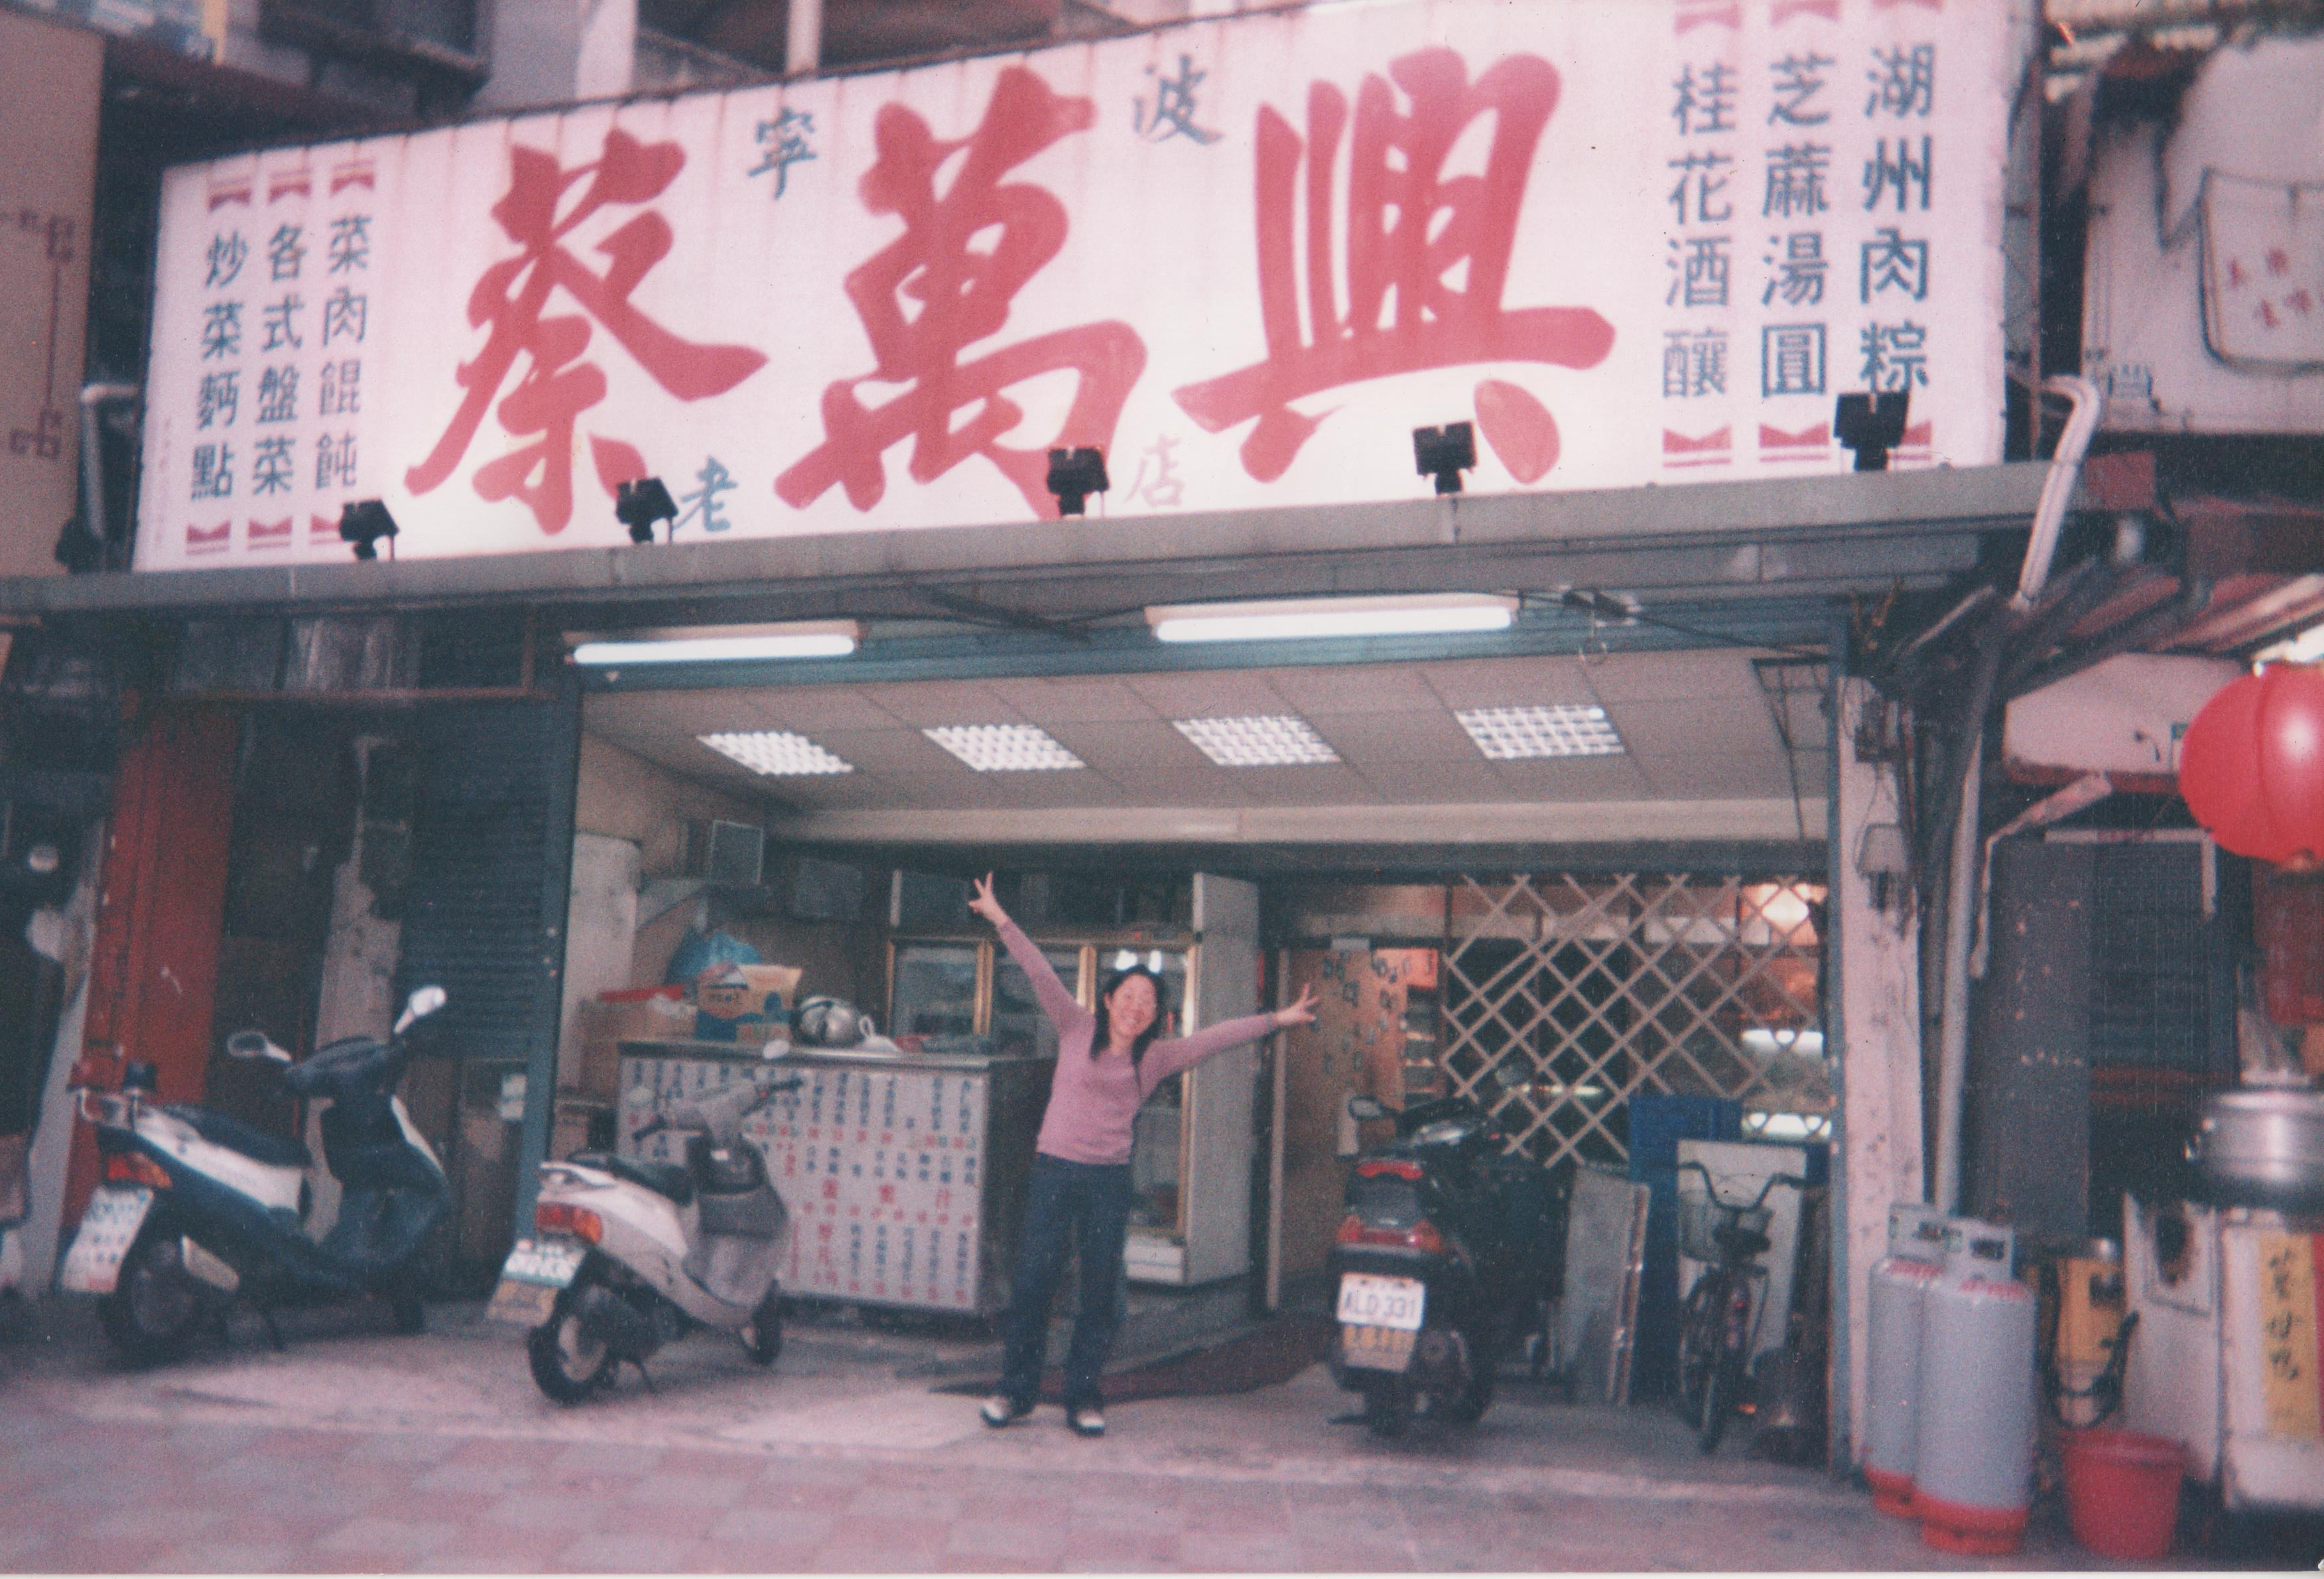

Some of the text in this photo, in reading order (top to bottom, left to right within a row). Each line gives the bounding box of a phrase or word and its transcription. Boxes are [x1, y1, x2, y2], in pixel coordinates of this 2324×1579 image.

[251, 224, 307, 496] 各式盤菜
[314, 213, 373, 490] 菜肉餛飩
[1663, 61, 1738, 399] 桂花酒釀
[1859, 42, 1937, 394] 湖州肉粽
